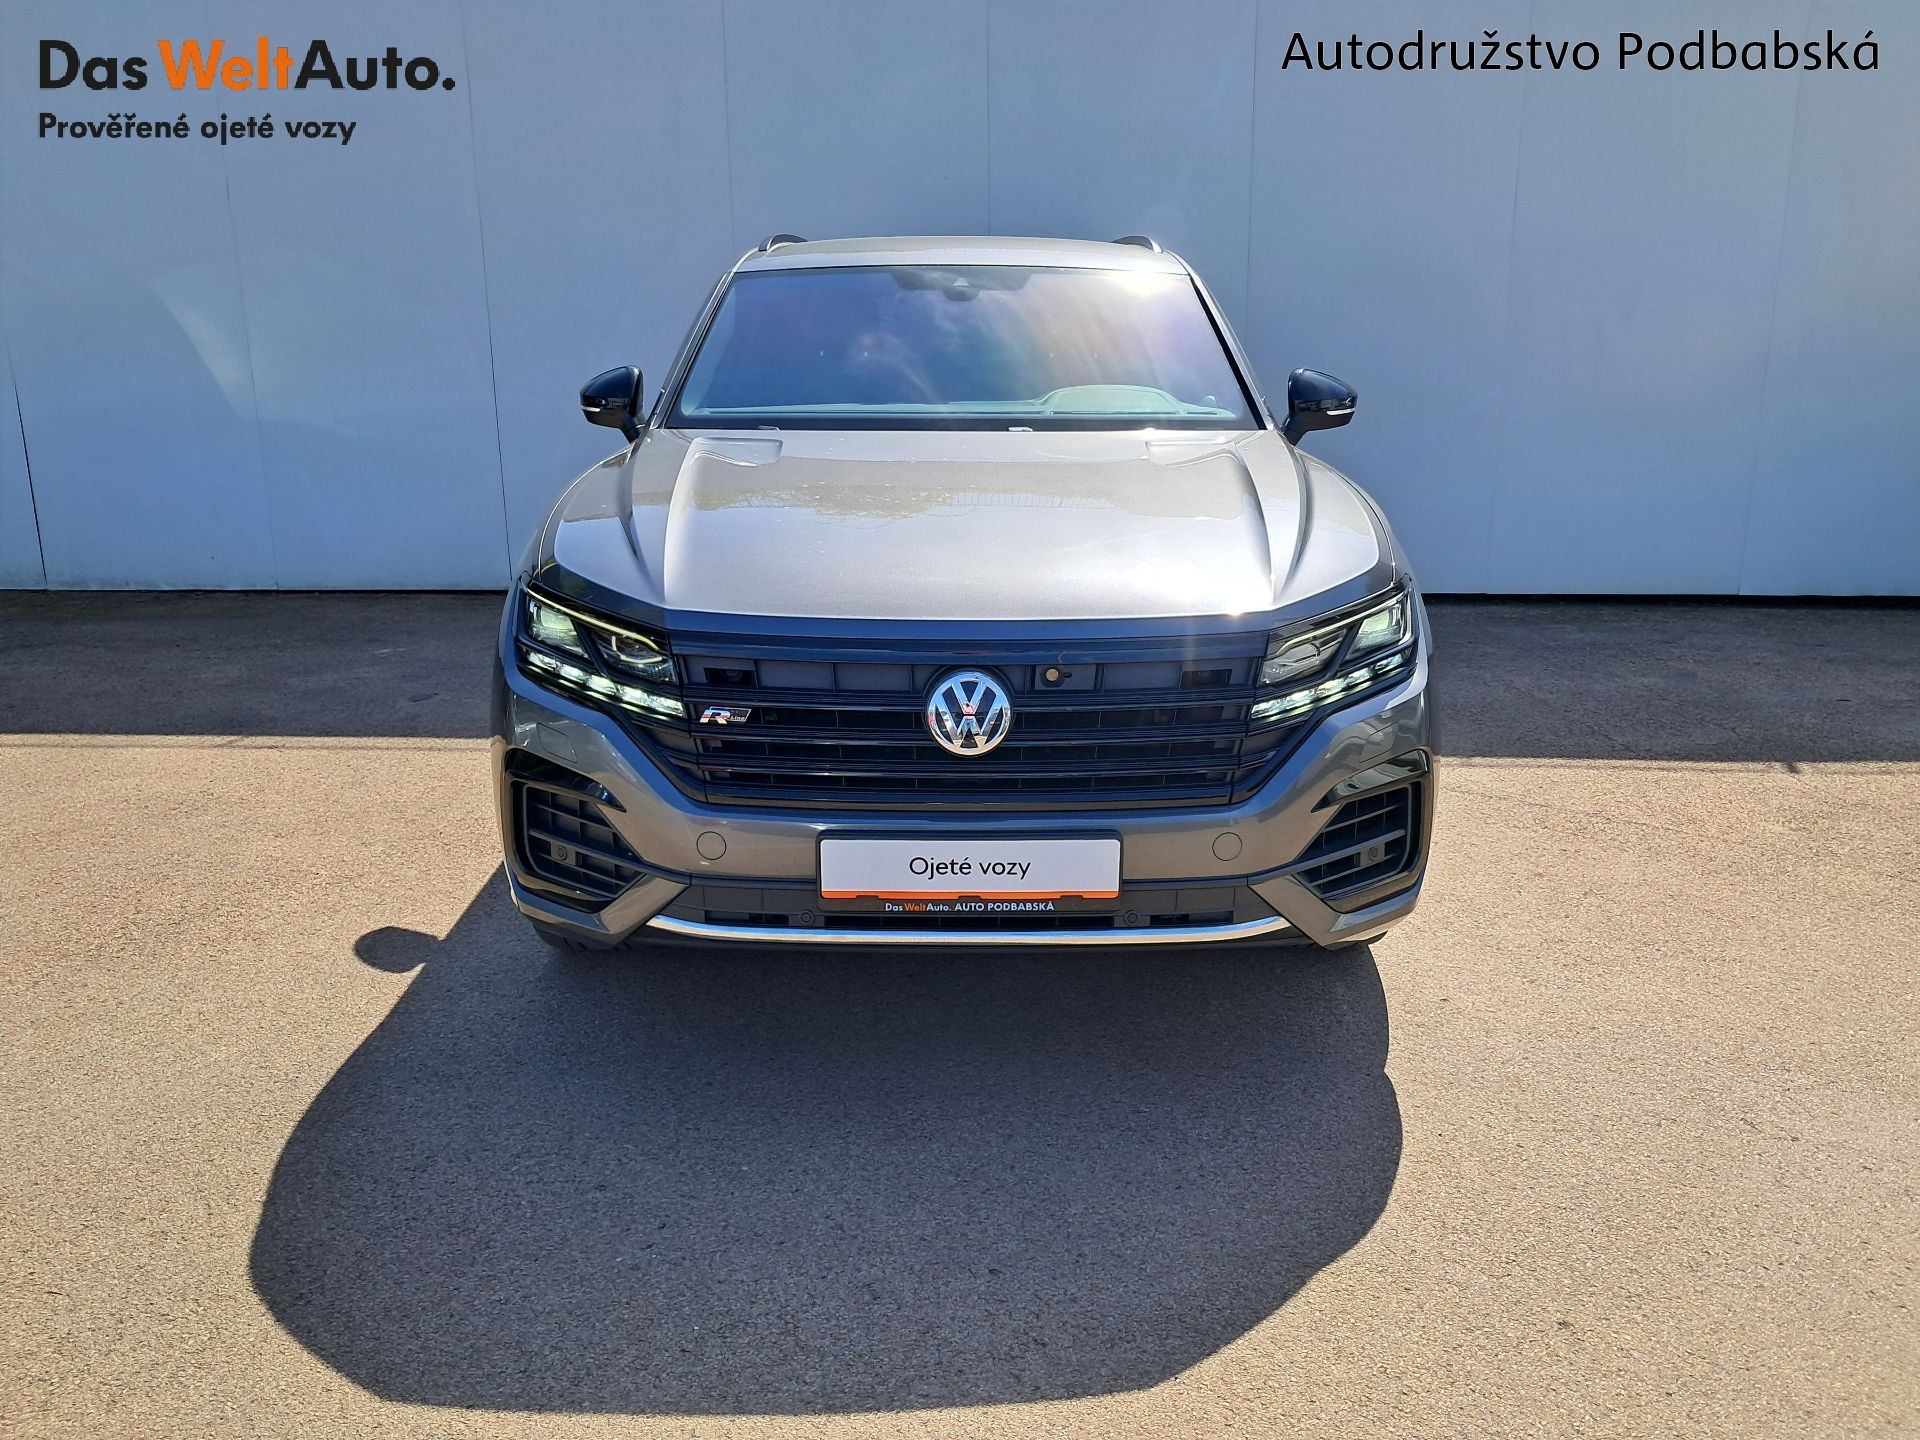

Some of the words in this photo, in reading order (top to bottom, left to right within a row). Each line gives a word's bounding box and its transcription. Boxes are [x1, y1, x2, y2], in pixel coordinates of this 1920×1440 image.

[909, 856, 972, 879] Ojeté
[979, 862, 1031, 880] vozy
[885, 902, 903, 911] Das
[905, 902, 952, 911] WeltAuto.
[955, 902, 985, 911] AUTO
[987, 900, 1055, 911] PODBABSKÁ
